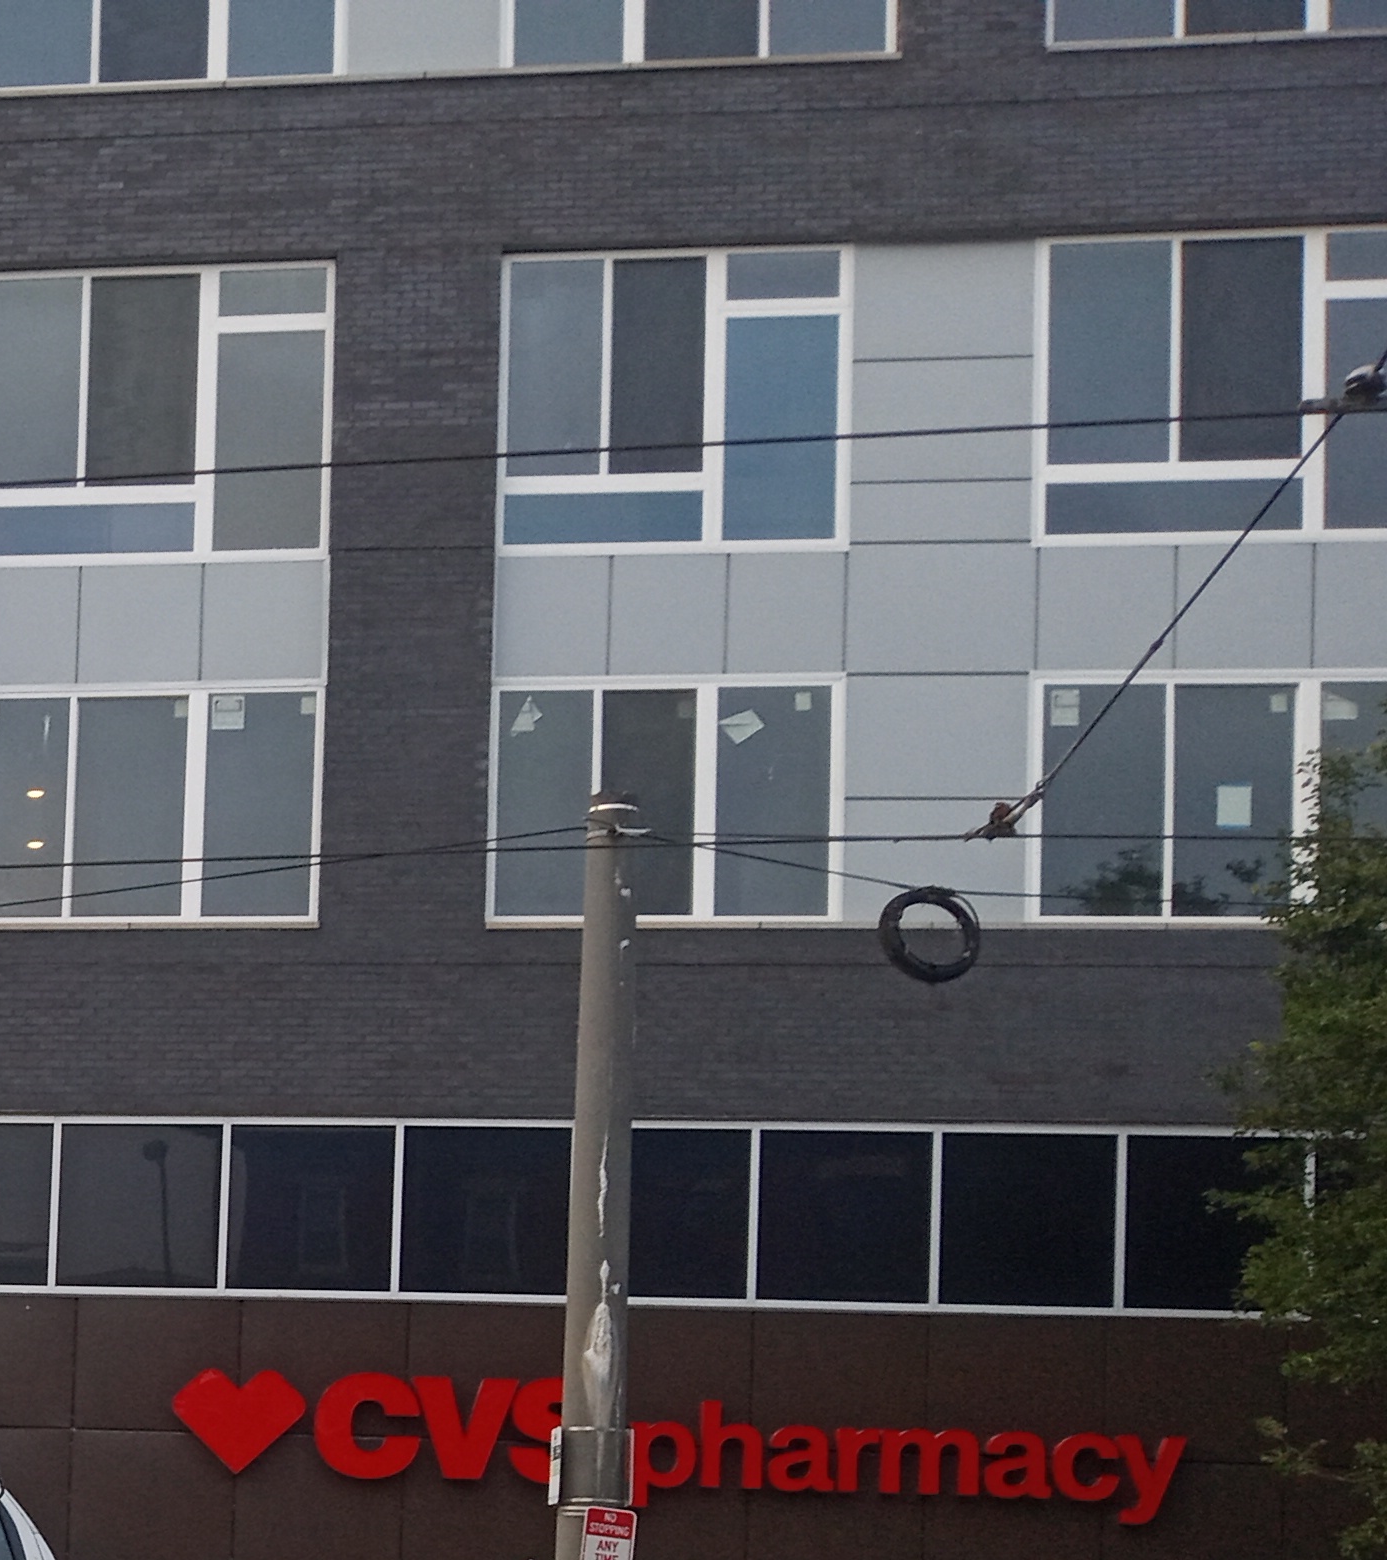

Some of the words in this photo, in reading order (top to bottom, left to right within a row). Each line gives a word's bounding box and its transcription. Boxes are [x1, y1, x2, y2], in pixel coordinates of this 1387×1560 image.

[631, 1400, 1187, 1525] pharmacy
[604, 1512, 618, 1523] NO
[588, 1521, 631, 1537] STOPPING
[595, 1540, 620, 1553] ANY
